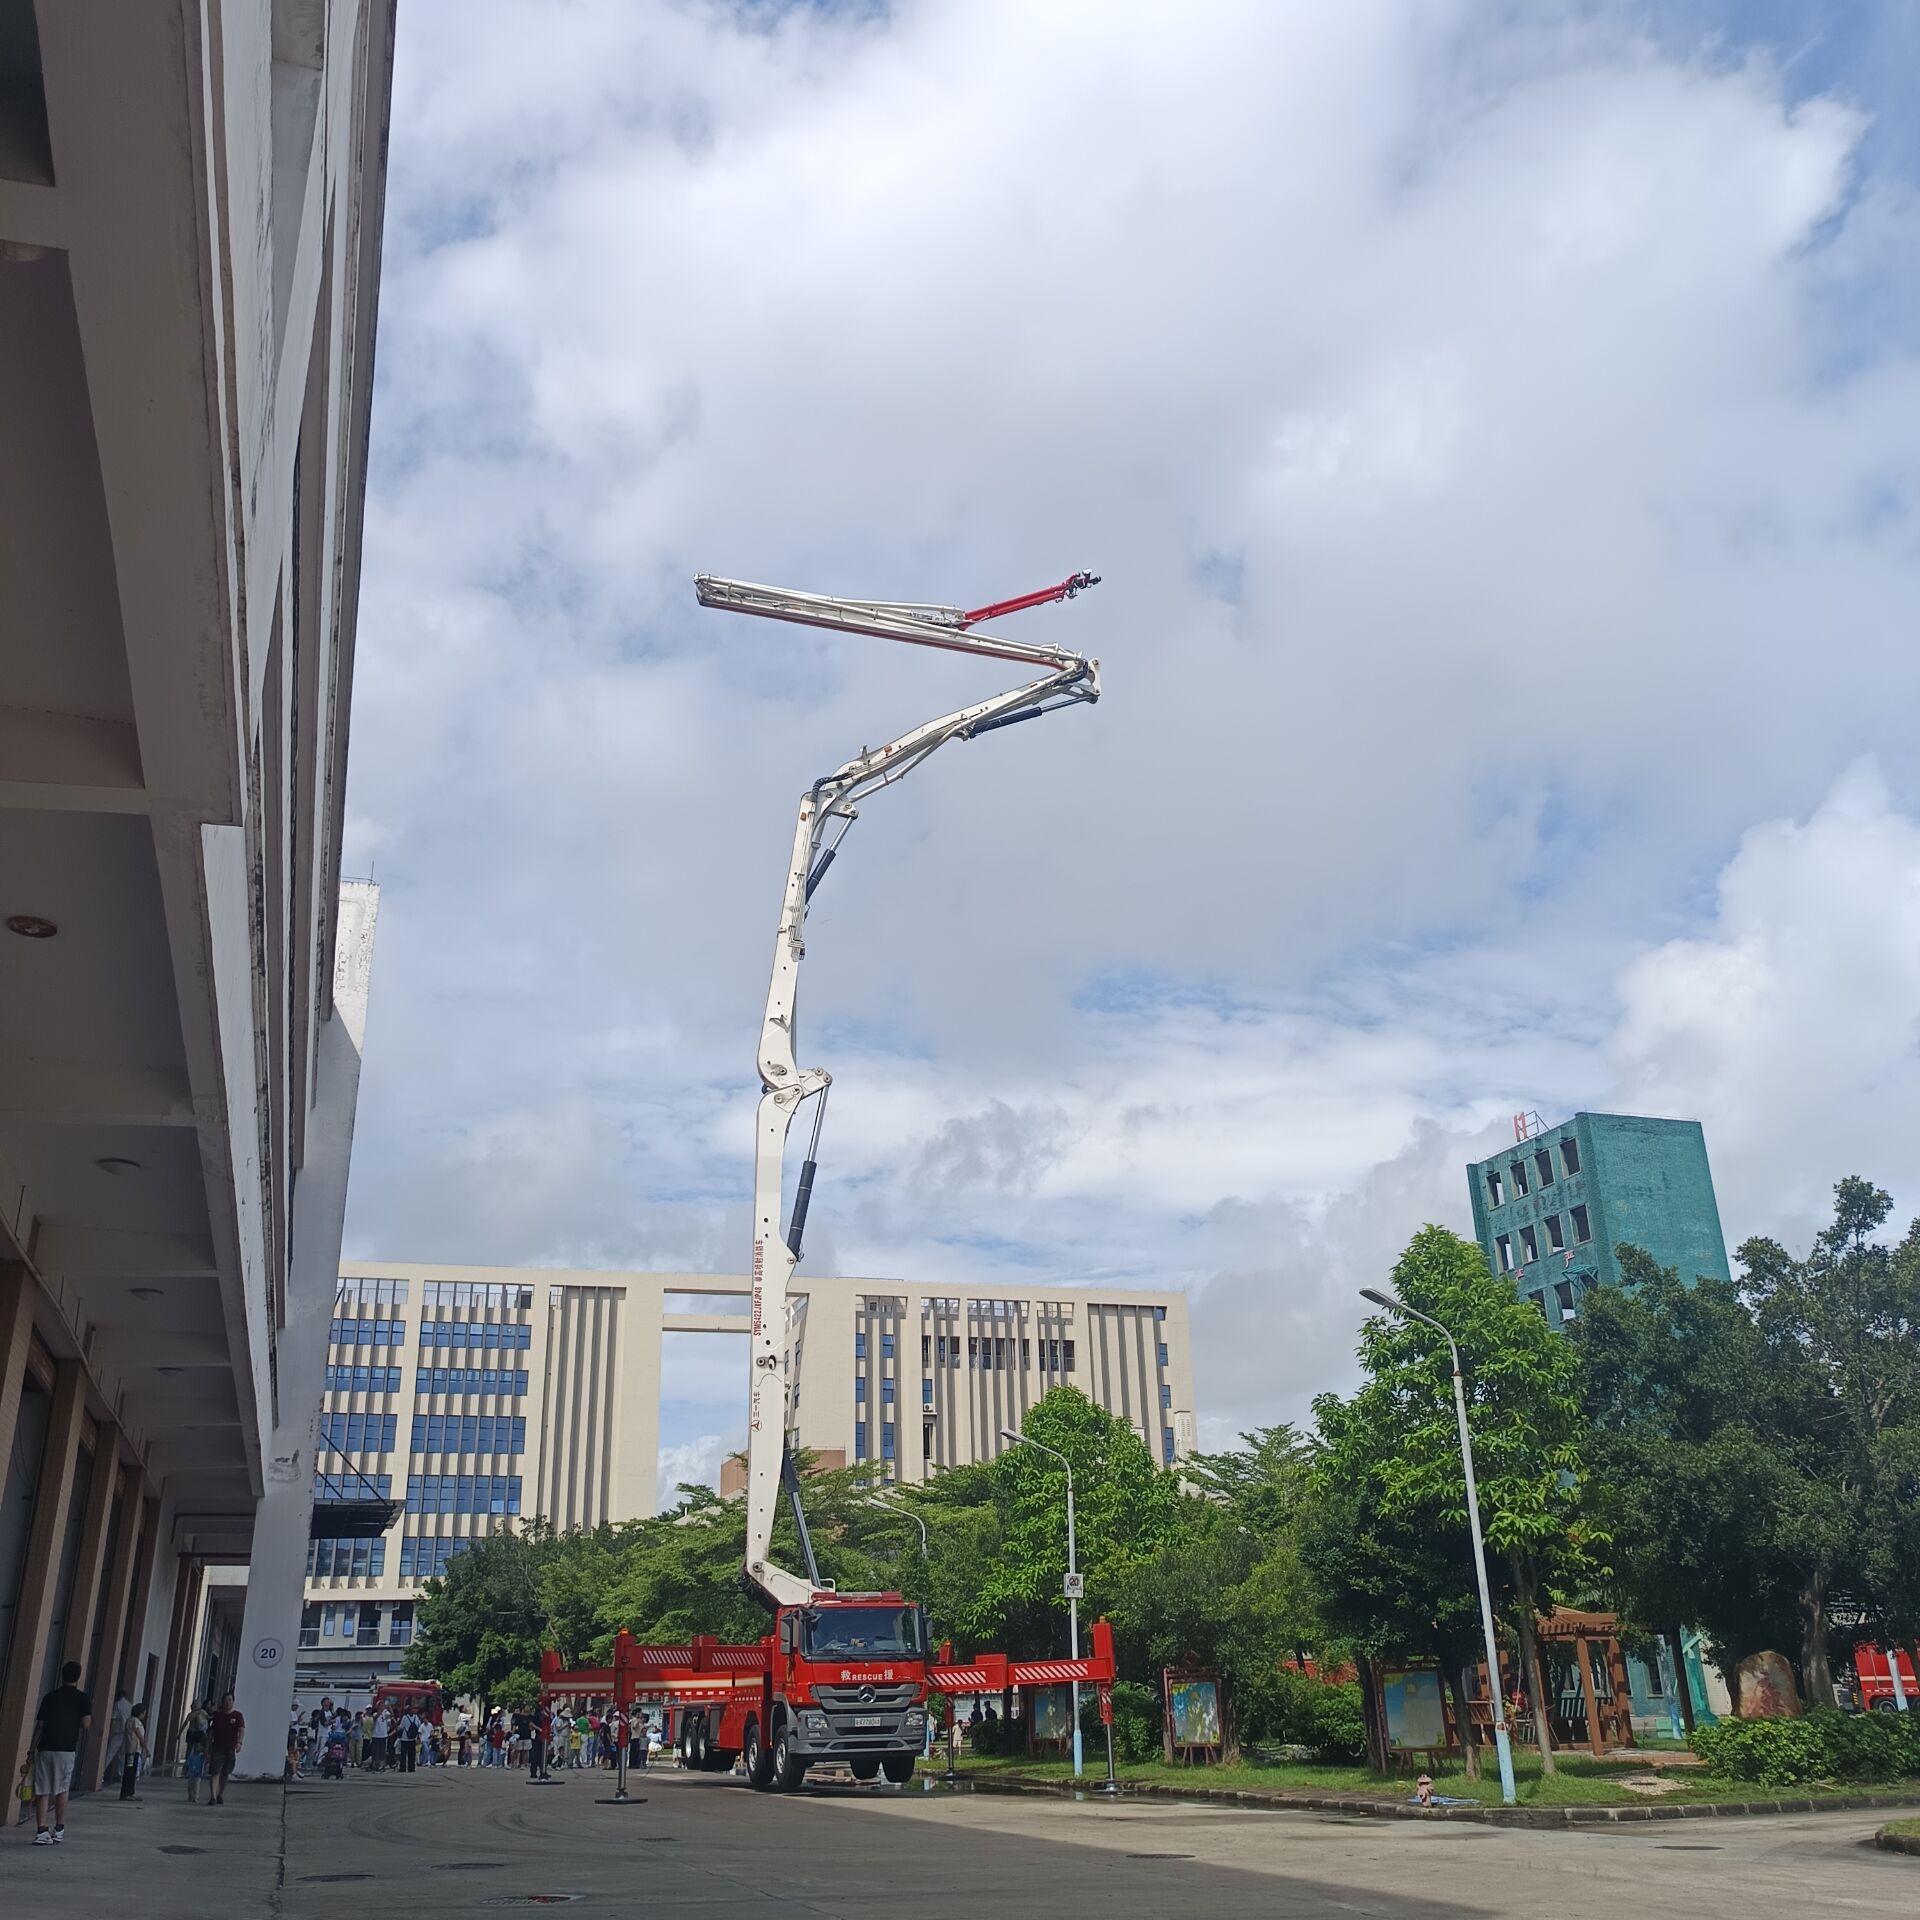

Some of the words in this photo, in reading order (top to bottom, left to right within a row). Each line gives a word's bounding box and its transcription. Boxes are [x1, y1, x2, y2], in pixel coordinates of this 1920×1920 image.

[752, 1391, 761, 1418] 三一汽车
[260, 1648, 276, 1659] 20
[852, 1673, 883, 1681] RESCUE
